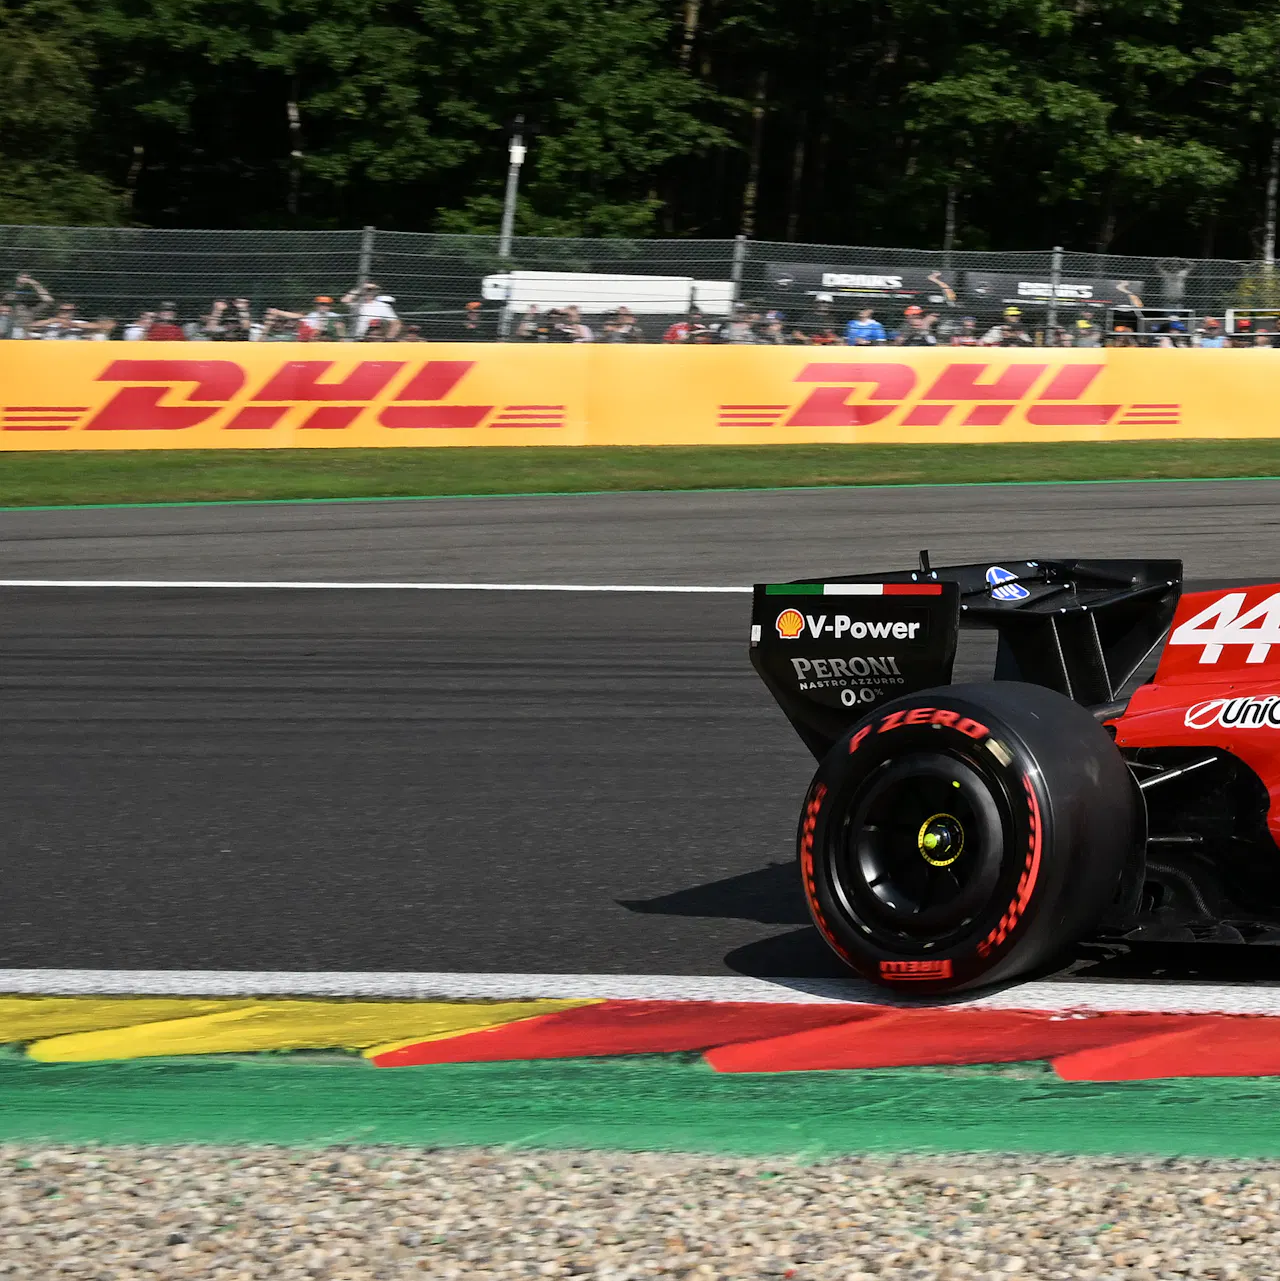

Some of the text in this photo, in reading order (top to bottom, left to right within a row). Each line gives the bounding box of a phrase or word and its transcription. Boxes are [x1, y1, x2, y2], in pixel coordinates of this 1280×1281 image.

[81, 360, 492, 430] DHL
[782, 363, 1120, 427] DHL
[806, 615, 920, 640] V-Power
[790, 656, 902, 680] PERONI
[799, 677, 905, 691] NASTRO AZZURRO
[877, 707, 991, 740] ZERO
